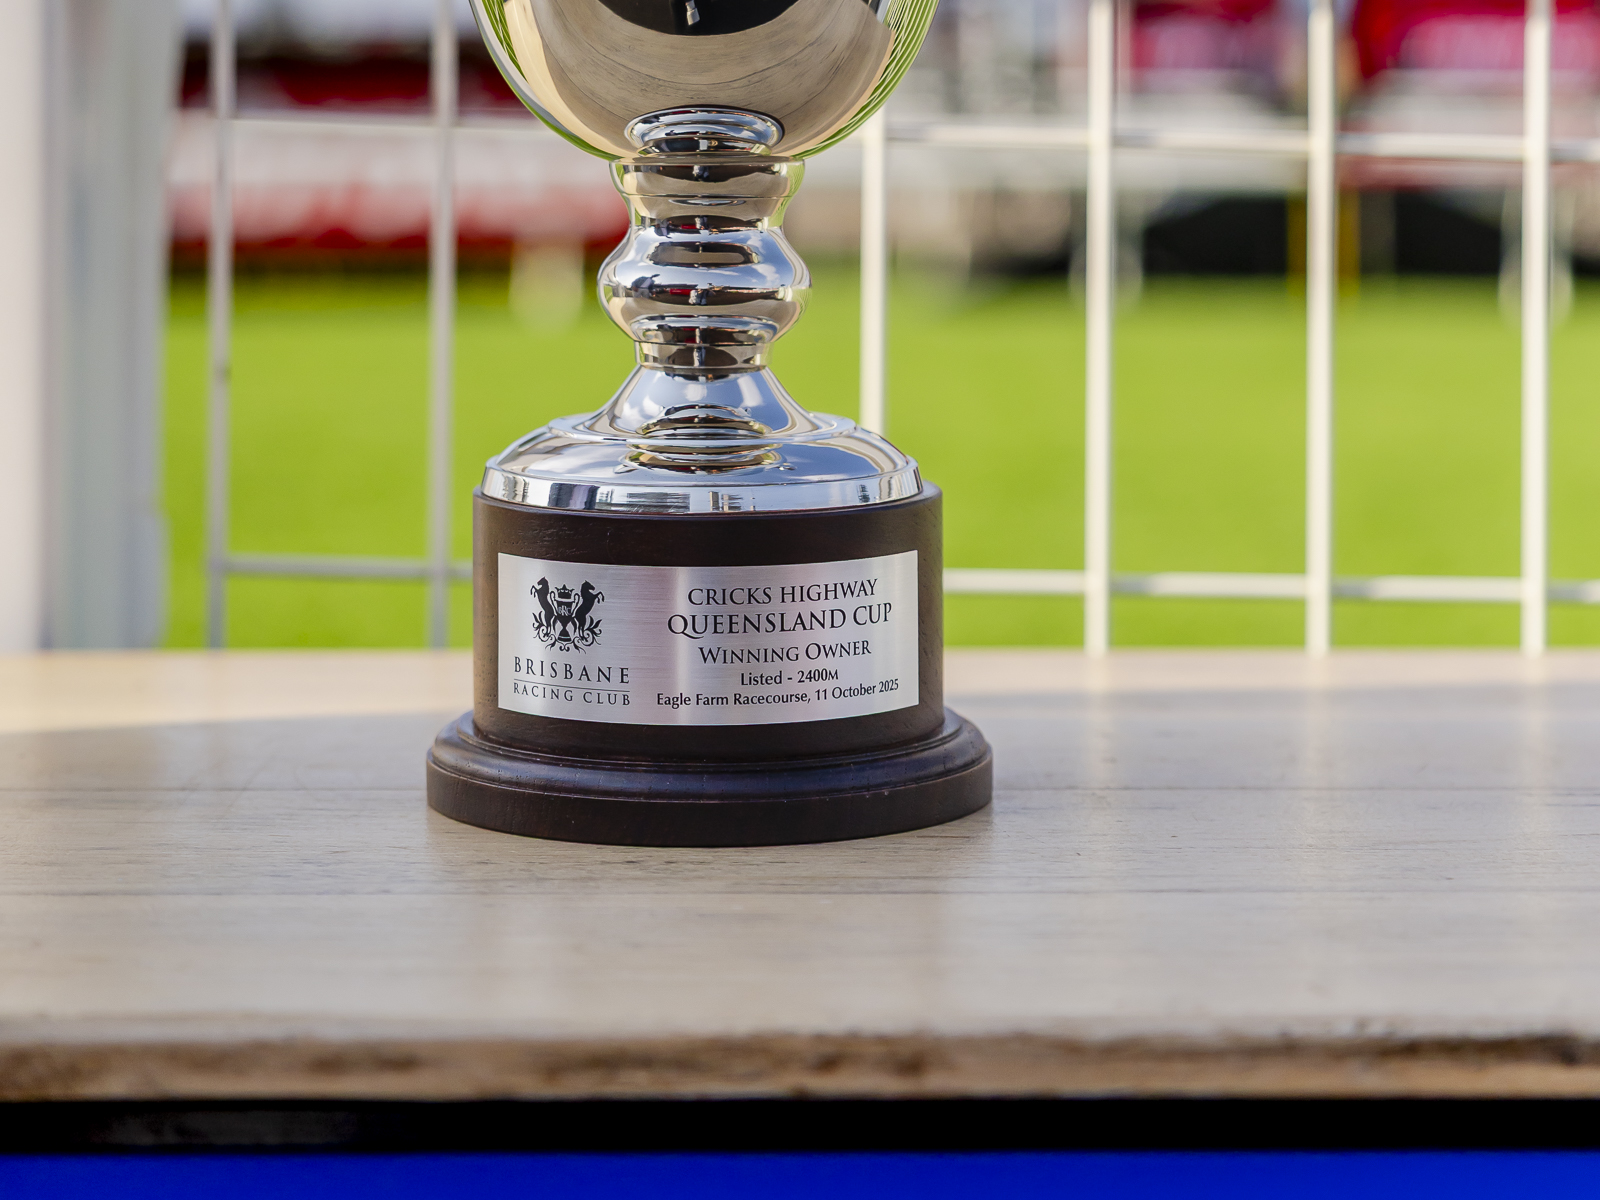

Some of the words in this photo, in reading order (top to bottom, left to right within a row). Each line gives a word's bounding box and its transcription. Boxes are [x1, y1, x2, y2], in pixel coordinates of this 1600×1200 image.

[688, 585, 772, 605] CRICKS
[779, 579, 878, 604] HIGHWAY
[667, 609, 847, 640] QUEENSLAND
[853, 602, 892, 626] CUP
[698, 647, 800, 664] WINNING
[805, 640, 872, 660] OWNER
[514, 656, 630, 684] BRISBANE
[741, 671, 782, 686] Listed
[514, 682, 574, 702] RACING
[583, 691, 631, 706] CLUB
[657, 693, 691, 710] Eagle
[696, 693, 729, 706] Farm
[733, 692, 811, 705] Racecourse,
[815, 688, 827, 701] 11
[831, 683, 877, 699] October
[878, 678, 899, 693] 2025
